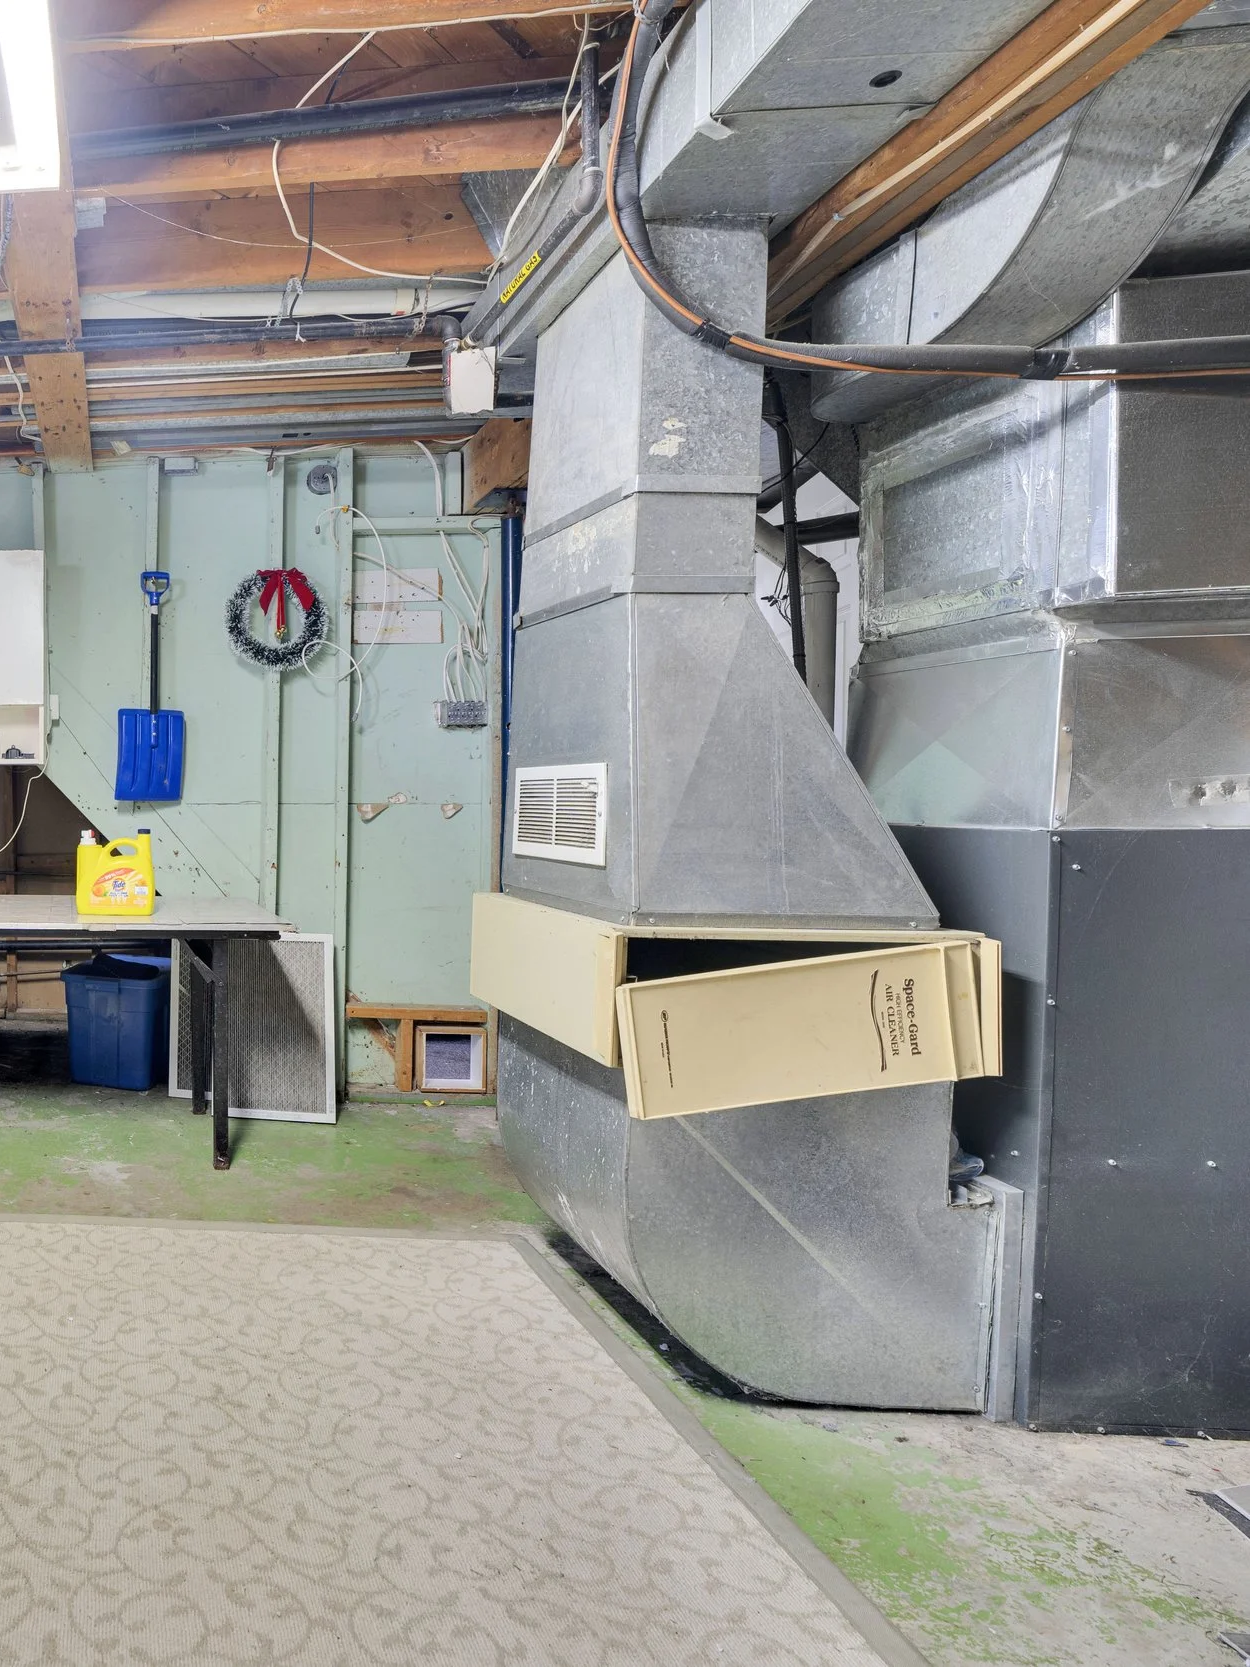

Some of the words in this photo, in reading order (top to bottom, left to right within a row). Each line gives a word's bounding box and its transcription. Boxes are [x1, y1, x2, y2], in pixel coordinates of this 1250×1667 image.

[502, 272, 526, 300] NATURAL
[112, 880, 126, 890] Tide
[885, 983, 894, 1002] AIR
[886, 1006, 900, 1056] CLEANER
[896, 1009, 905, 1043] EFFICIENCY
[902, 978, 921, 1056] Space-Gard
